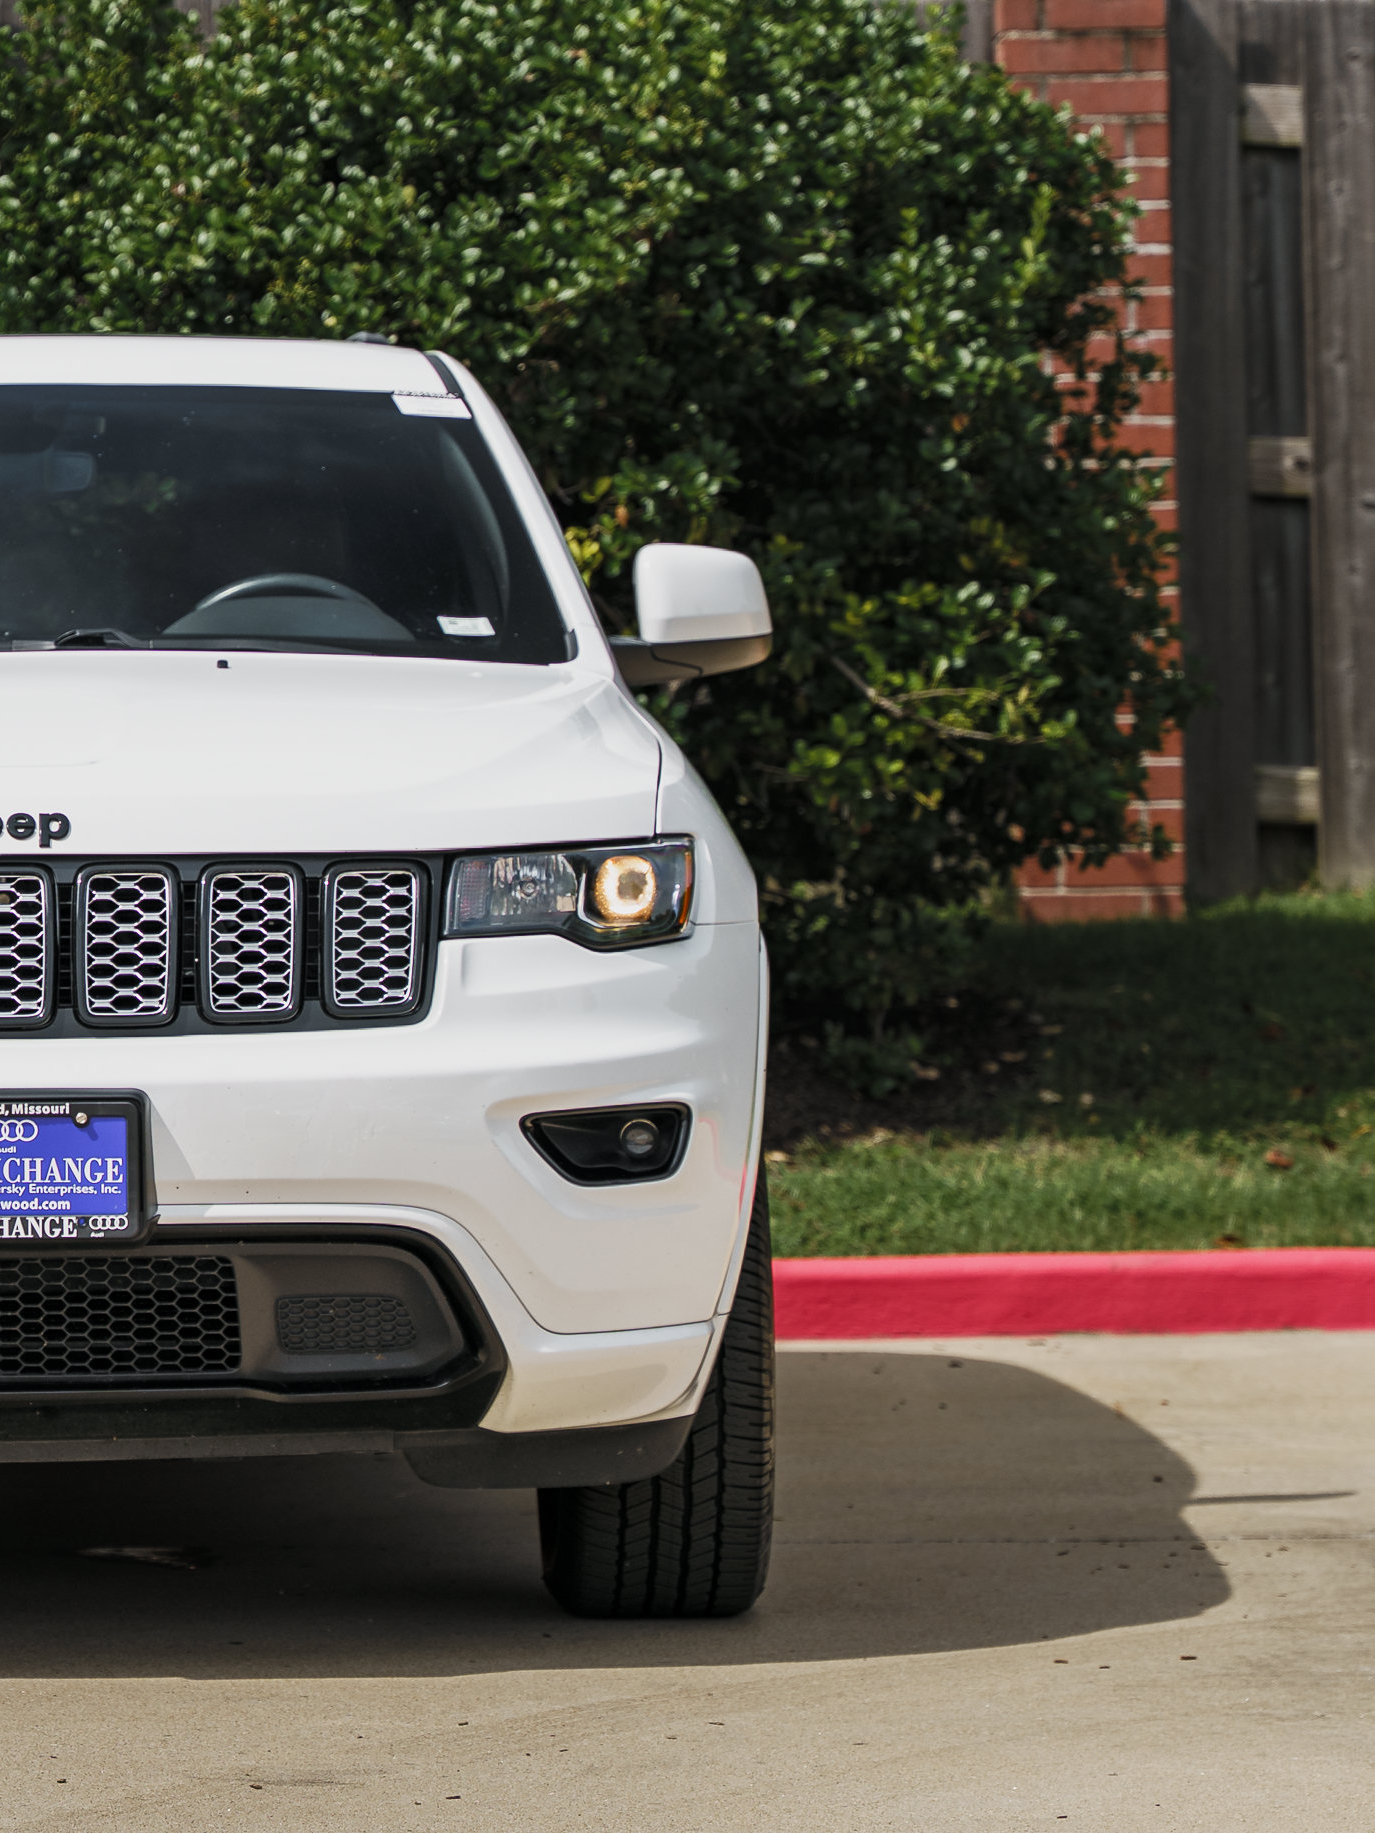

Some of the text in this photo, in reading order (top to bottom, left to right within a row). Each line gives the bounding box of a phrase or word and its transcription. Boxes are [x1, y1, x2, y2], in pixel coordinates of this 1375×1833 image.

[11, 1103, 70, 1115] Missouri
[28, 1184, 98, 1196] Enterprises,
[100, 1184, 122, 1194] Inc.
